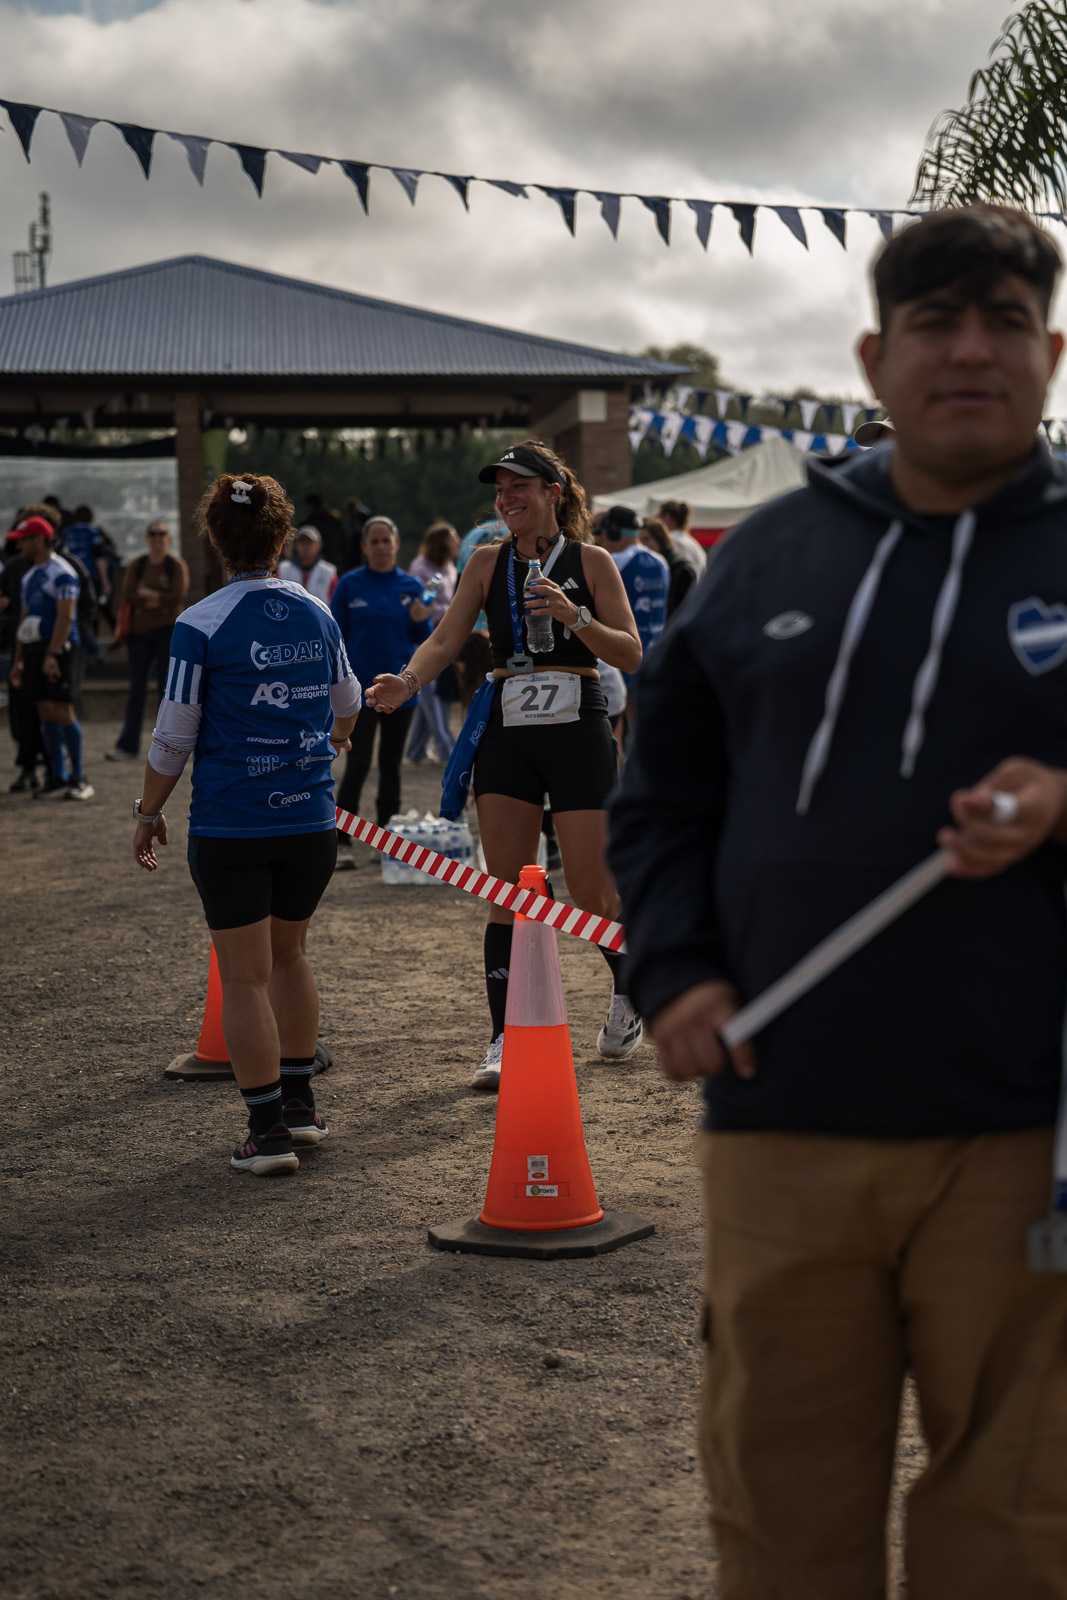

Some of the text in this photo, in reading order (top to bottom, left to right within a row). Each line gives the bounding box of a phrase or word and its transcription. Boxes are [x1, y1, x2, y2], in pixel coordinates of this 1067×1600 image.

[252, 640, 324, 667] CEDAR
[250, 681, 290, 709] AQ
[291, 685, 320, 694] COMUNA
[291, 690, 329, 700] AREQUITO
[519, 684, 560, 712] 27
